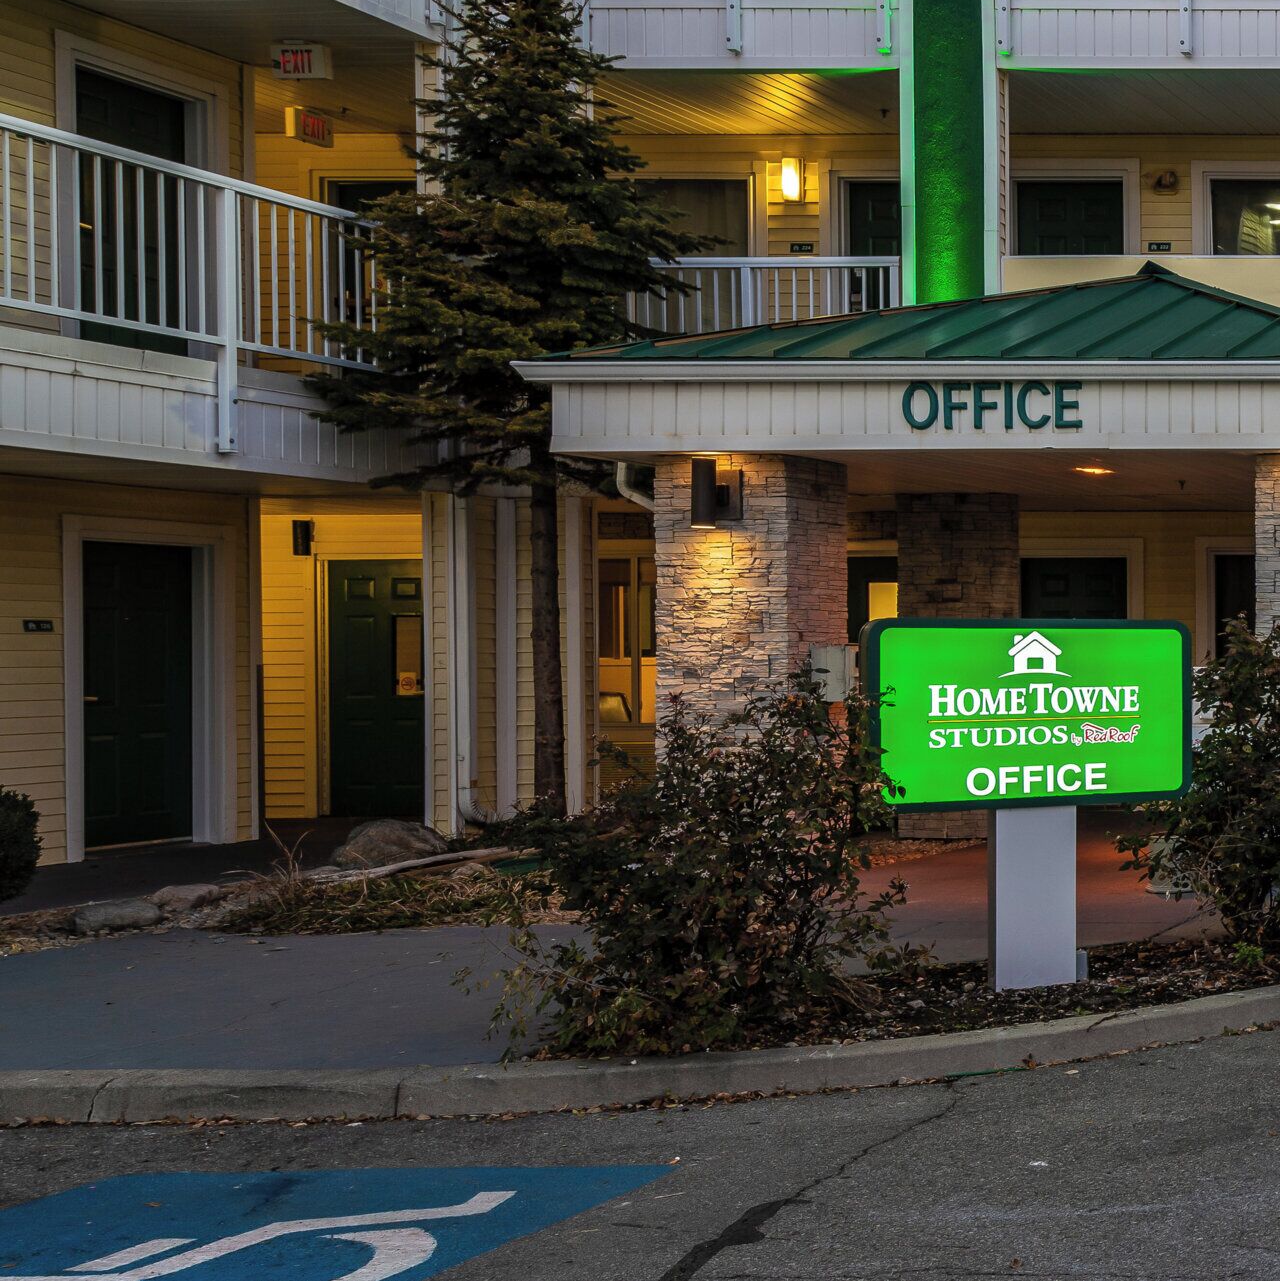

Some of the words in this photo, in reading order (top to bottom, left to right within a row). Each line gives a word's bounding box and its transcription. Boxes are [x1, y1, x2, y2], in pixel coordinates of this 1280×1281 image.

[280, 48, 314, 75] EXIT
[301, 112, 328, 142] EXIT
[902, 380, 1084, 431] OFFICE
[929, 725, 1069, 749] STUDIOS
[1071, 733, 1083, 747] by
[967, 763, 1108, 797] OFFICE
